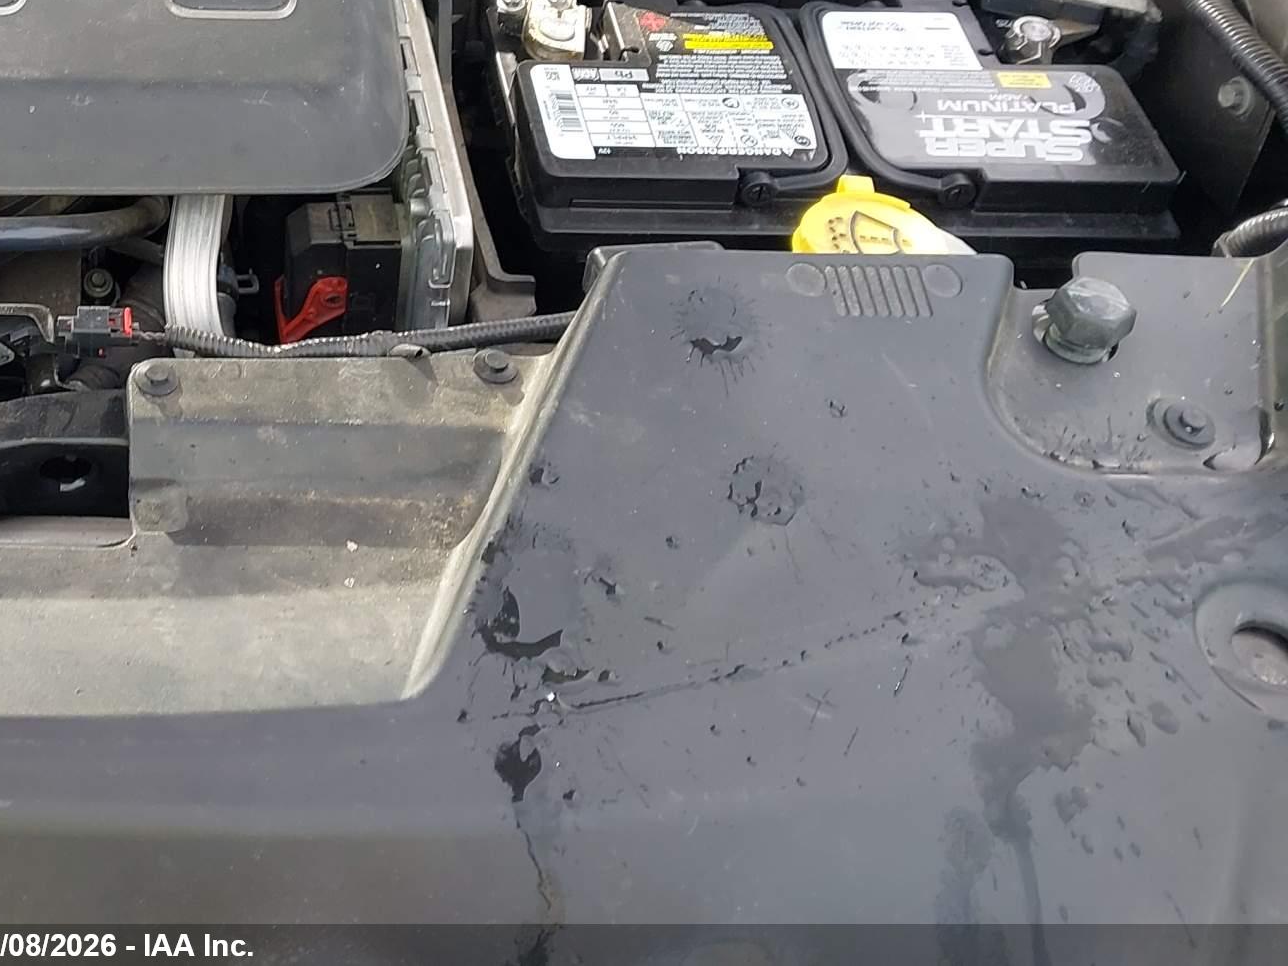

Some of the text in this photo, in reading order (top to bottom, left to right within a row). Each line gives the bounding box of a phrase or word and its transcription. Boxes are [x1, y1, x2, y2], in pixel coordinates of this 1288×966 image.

[937, 99, 1076, 114] PLATINUM
[918, 118, 1092, 146] START
[924, 138, 1083, 162] SUPER
